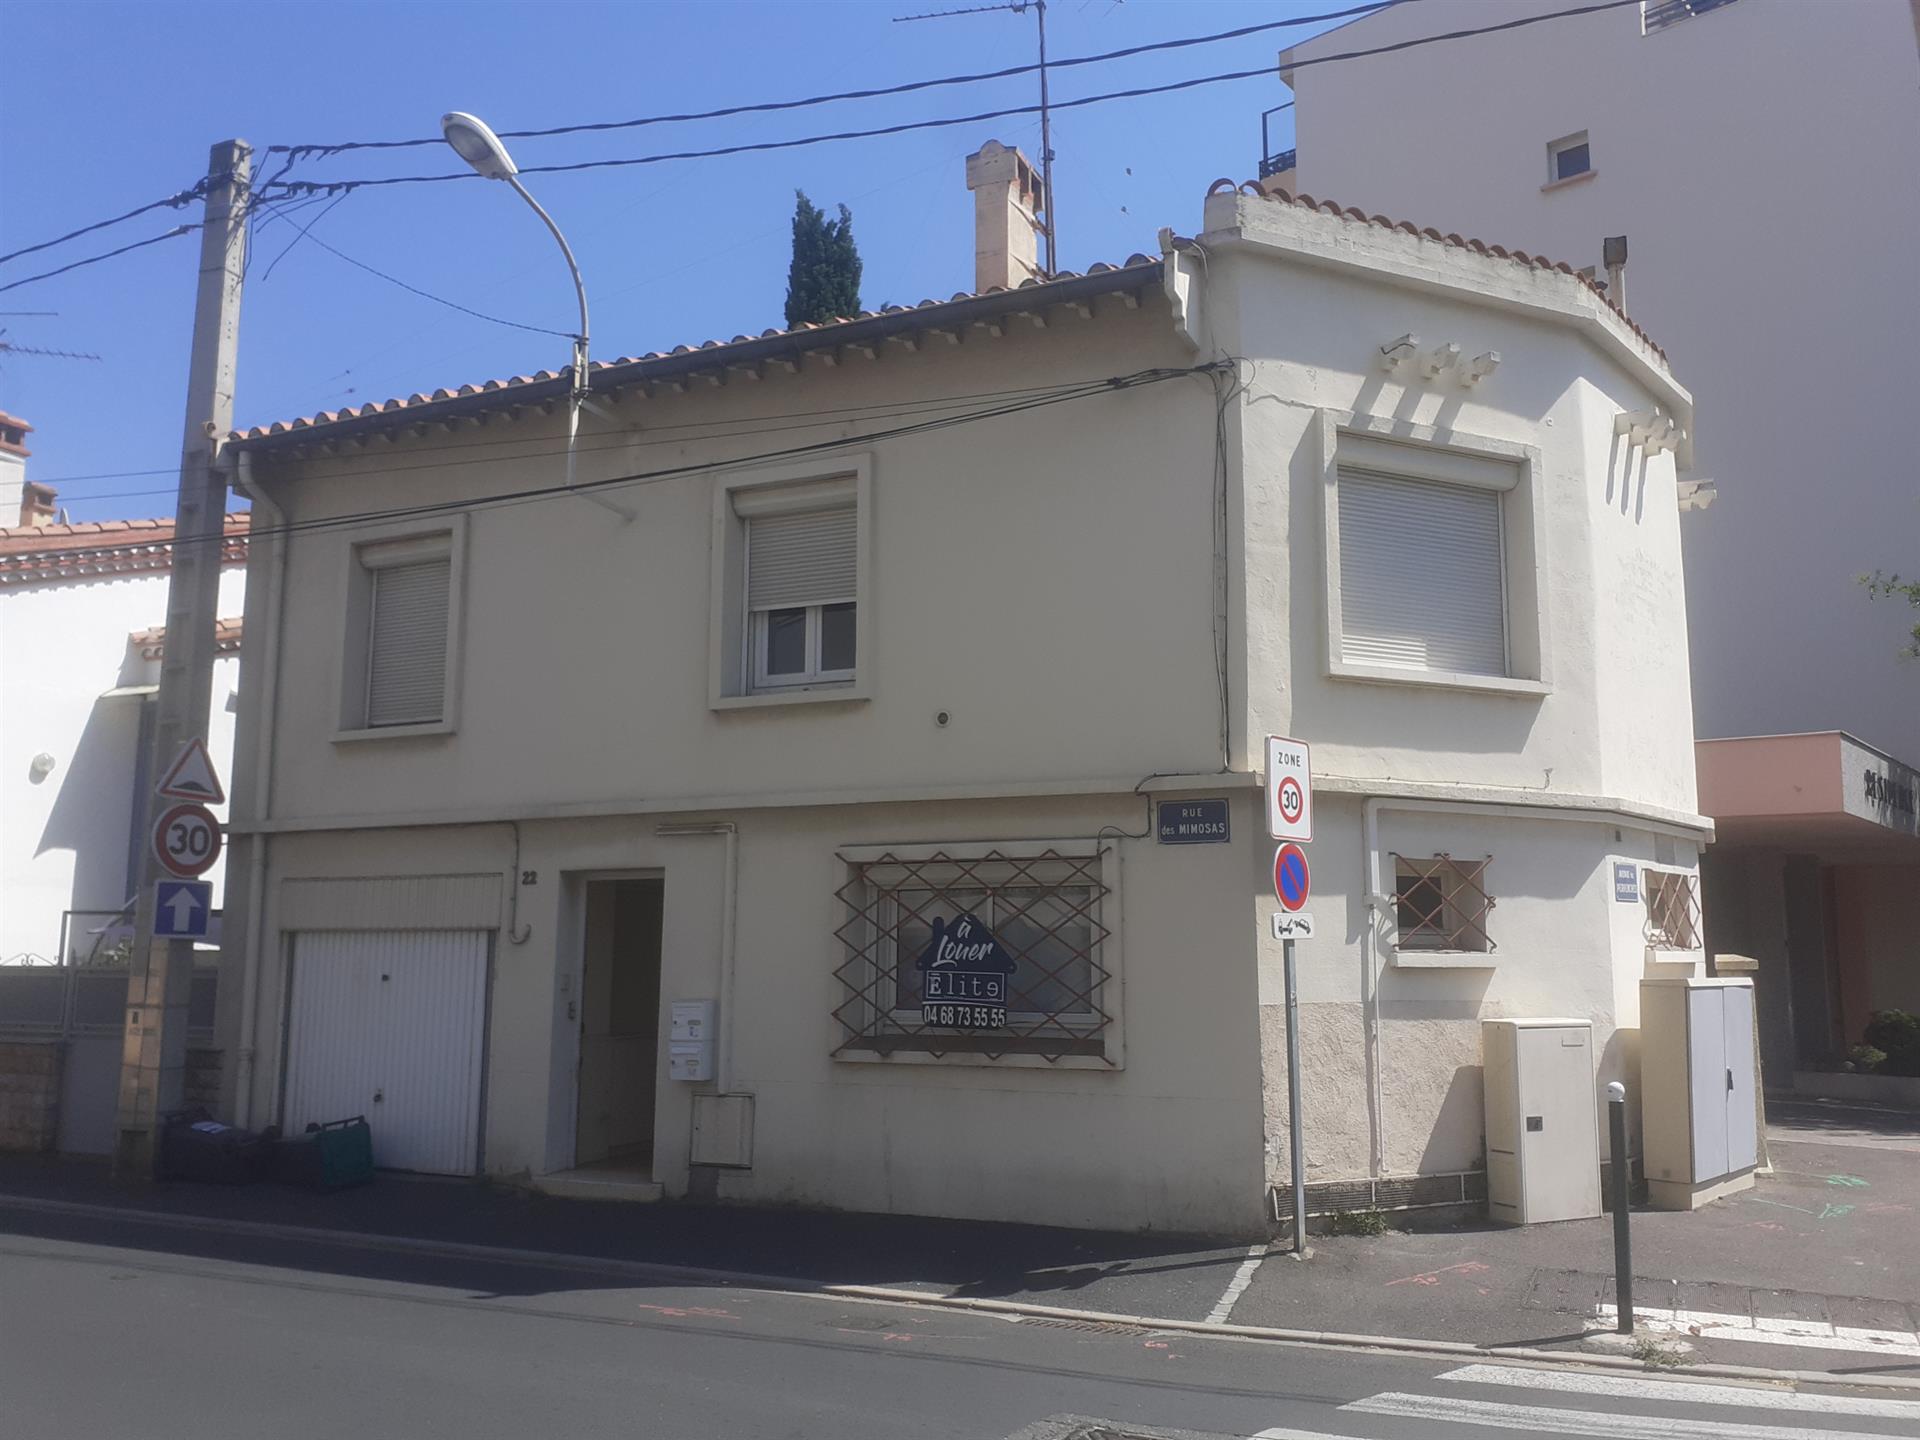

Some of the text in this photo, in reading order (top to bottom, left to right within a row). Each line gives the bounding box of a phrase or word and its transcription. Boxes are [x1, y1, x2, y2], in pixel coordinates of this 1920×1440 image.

[1278, 752, 1301, 767] ZONE
[1283, 790, 1298, 810] 30
[1182, 808, 1203, 817] RUE
[1162, 823, 1225, 835] des MIMOSAS
[169, 823, 210, 857] 30
[522, 871, 537, 885] 22
[931, 935, 994, 968] Louer
[924, 1006, 1005, 1028] 04 68 73 55 55
